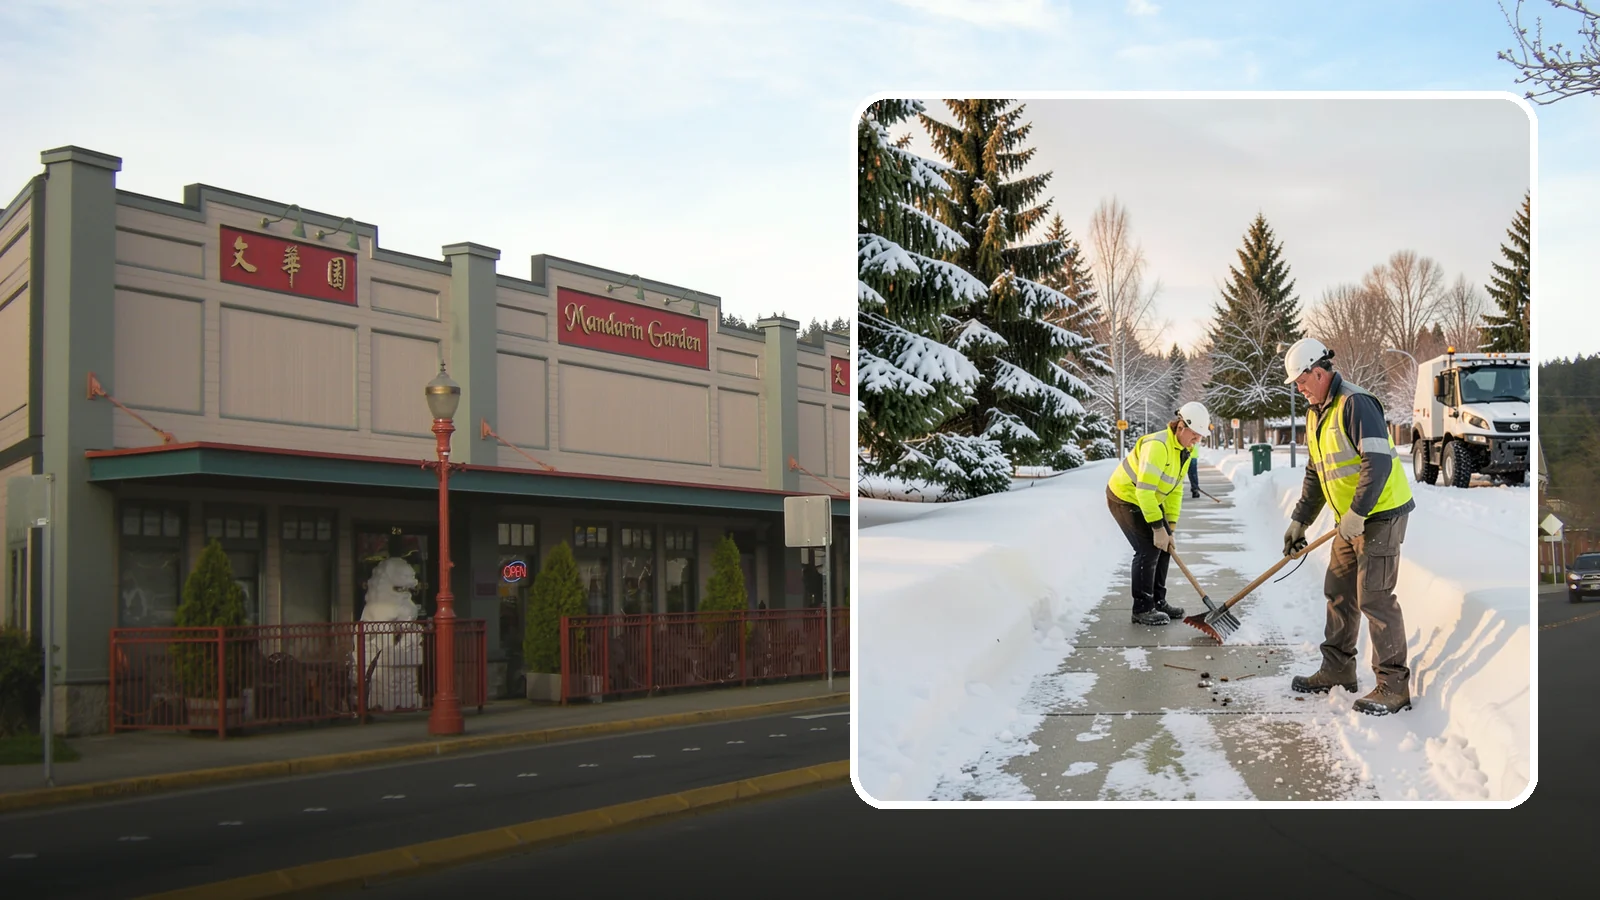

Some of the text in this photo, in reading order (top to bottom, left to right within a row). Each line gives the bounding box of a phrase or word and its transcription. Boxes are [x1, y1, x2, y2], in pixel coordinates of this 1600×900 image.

[231, 236, 346, 291] 文華園
[565, 302, 701, 352] Mandarin Garden
[503, 565, 527, 578] OPEN
